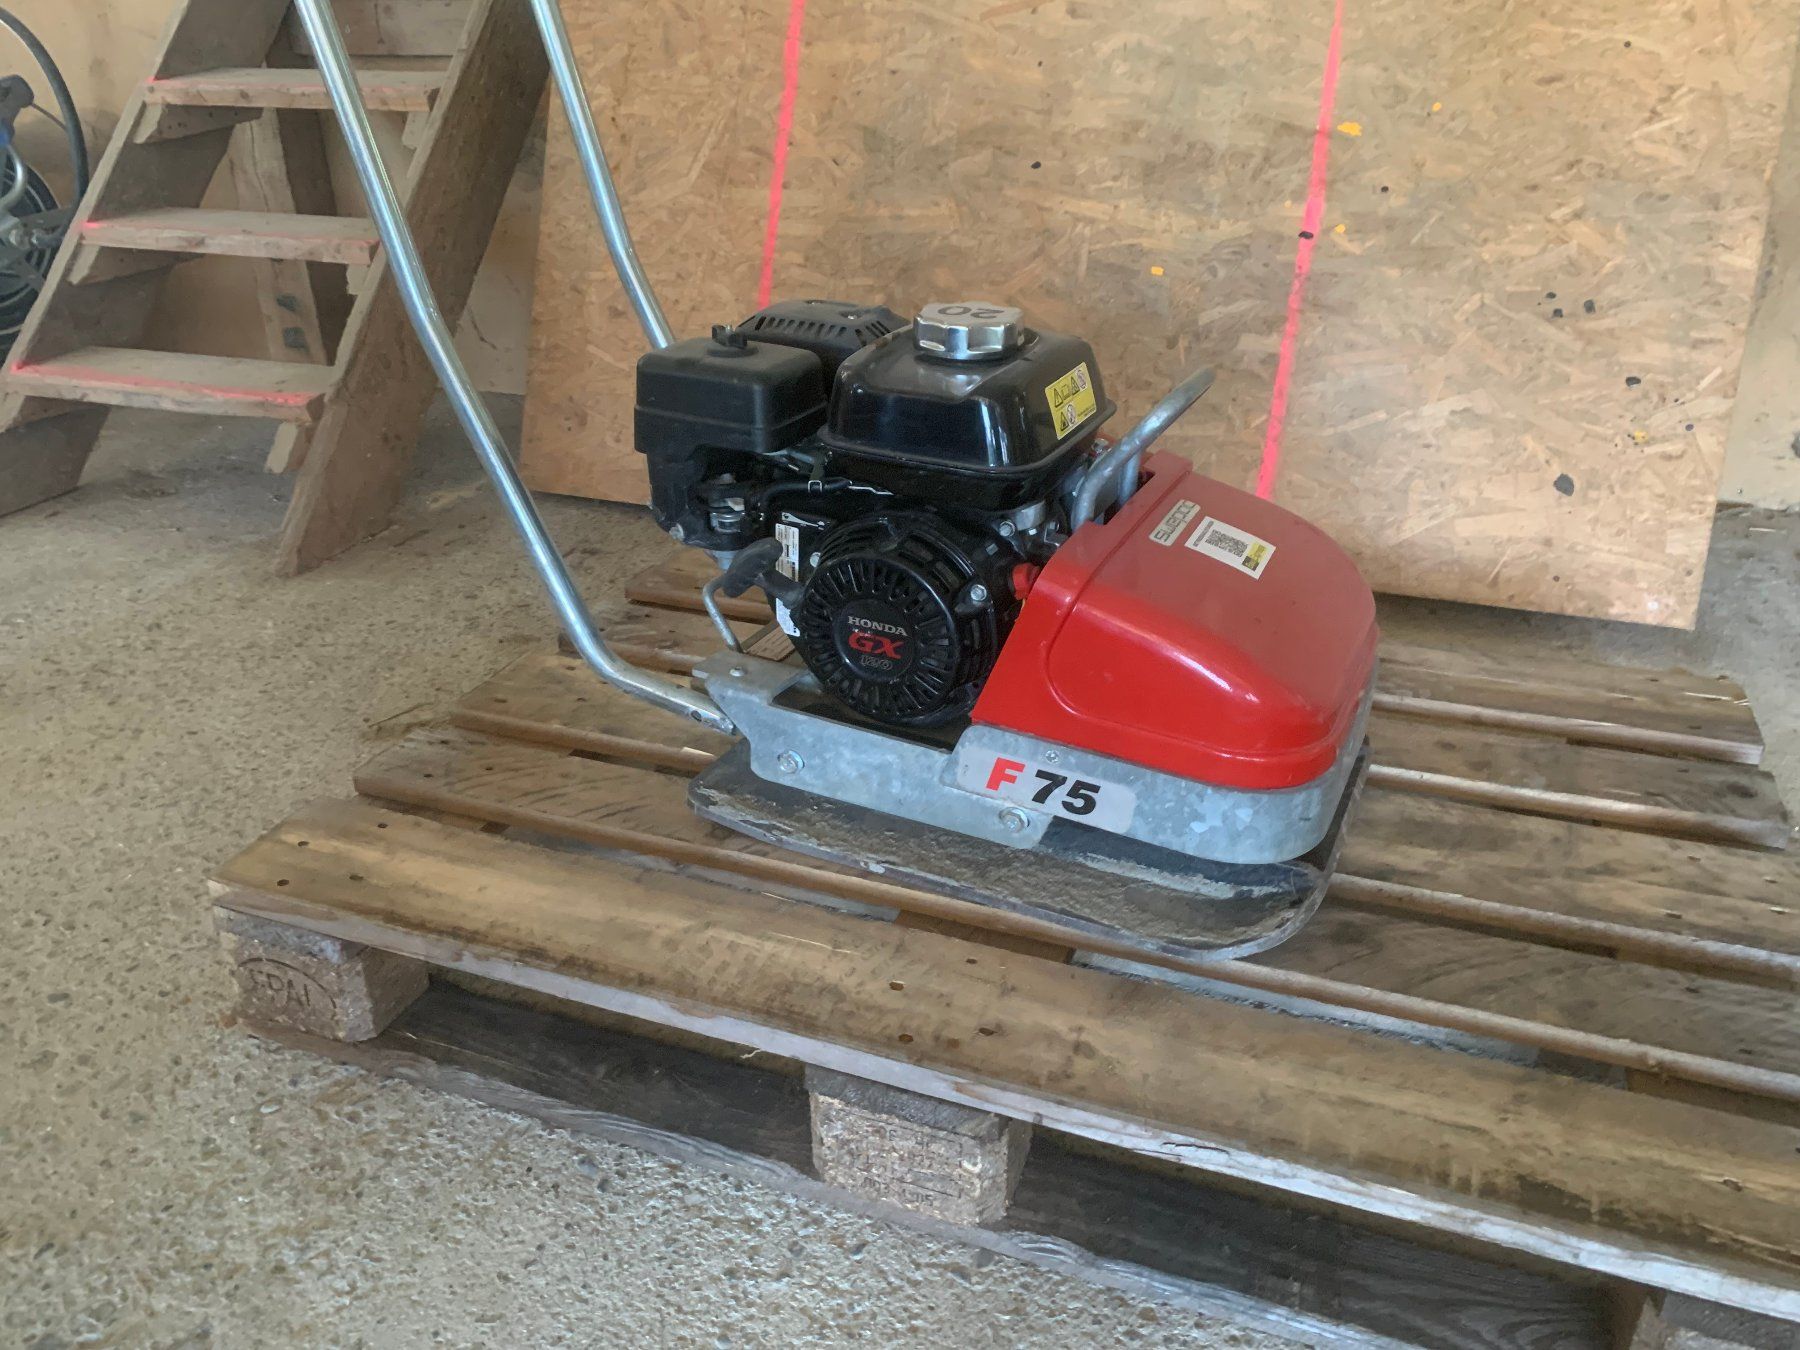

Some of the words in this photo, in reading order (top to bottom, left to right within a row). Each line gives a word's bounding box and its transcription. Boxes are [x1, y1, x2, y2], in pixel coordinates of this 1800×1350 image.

[847, 615, 908, 637] HONDA
[847, 630, 904, 660] GX
[985, 757, 1026, 791] F
[1031, 768, 1101, 815] 75
